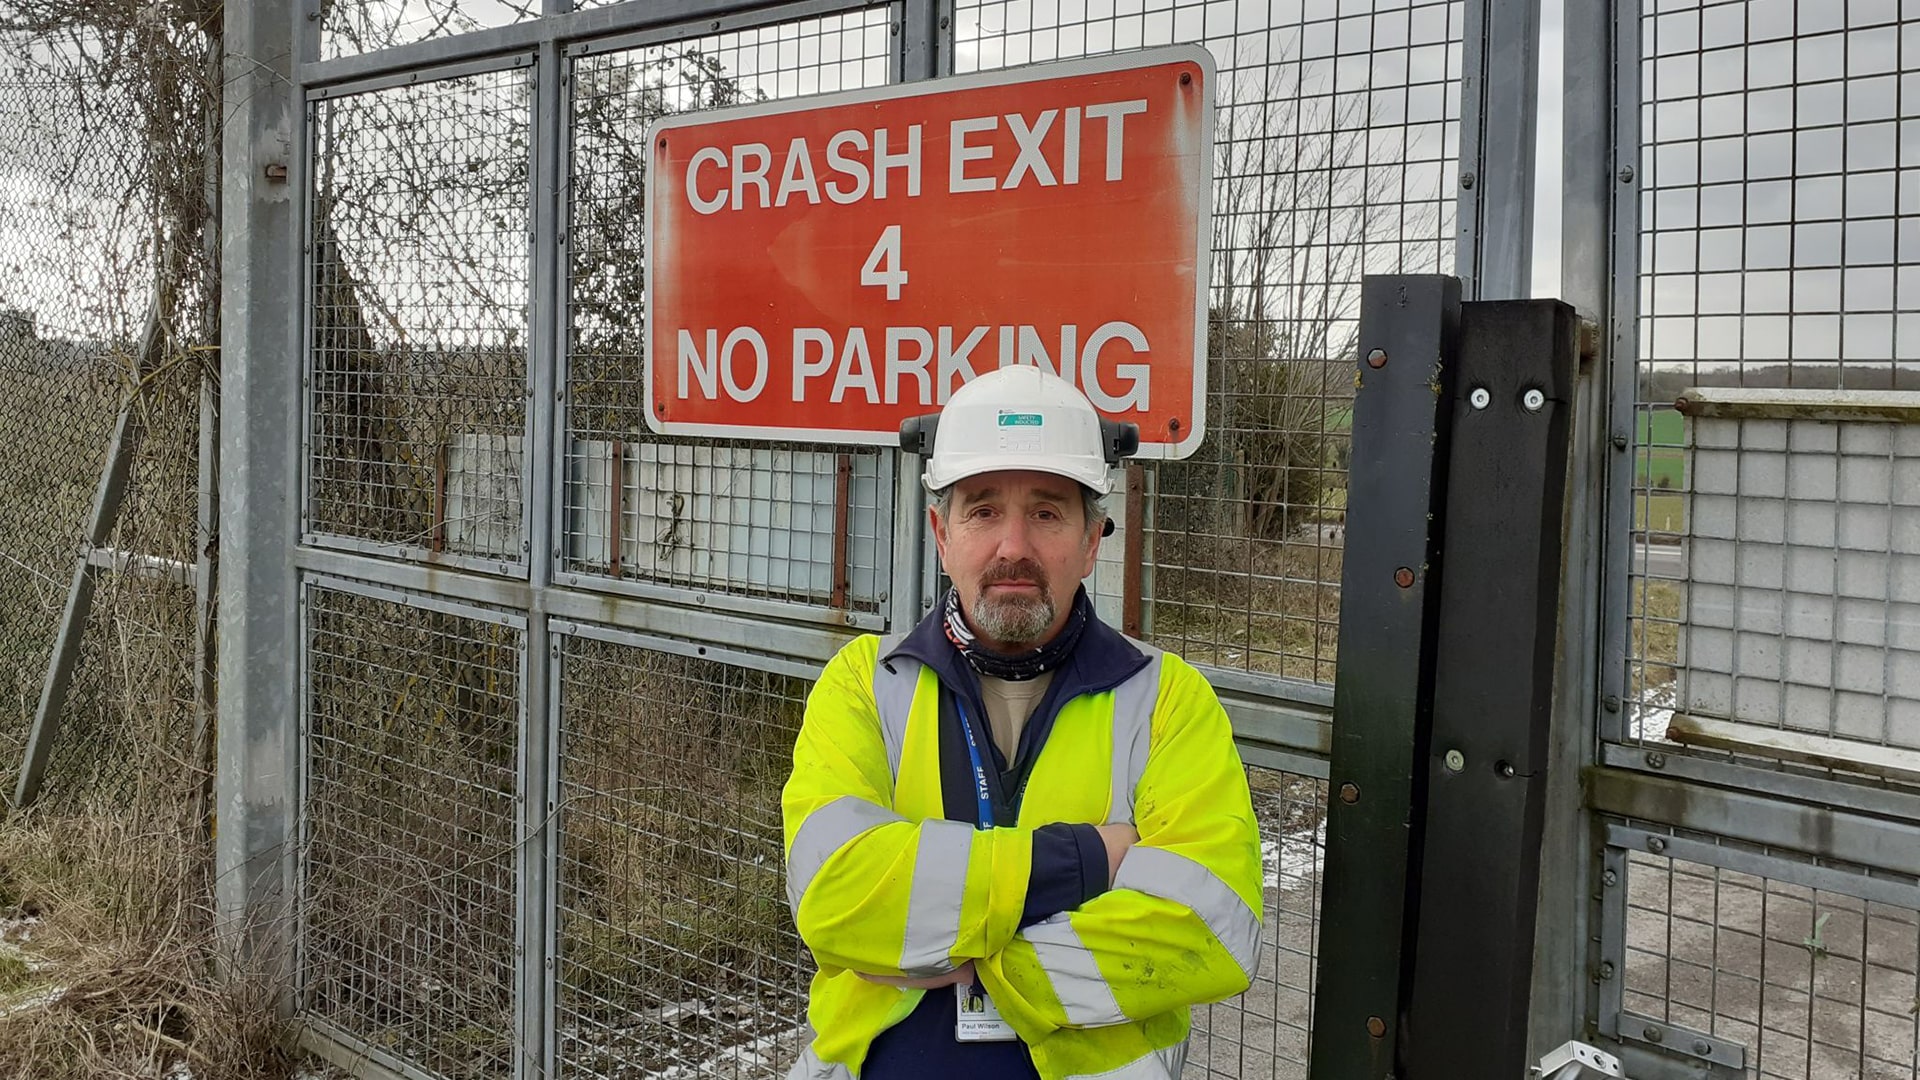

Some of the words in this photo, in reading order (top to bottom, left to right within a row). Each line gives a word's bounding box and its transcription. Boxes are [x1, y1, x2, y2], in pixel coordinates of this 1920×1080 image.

[685, 124, 922, 215] CRASH
[949, 98, 1148, 194] EXIT
[860, 224, 909, 301] 4
[677, 326, 769, 403] NO
[976, 766, 989, 800] STAFF
